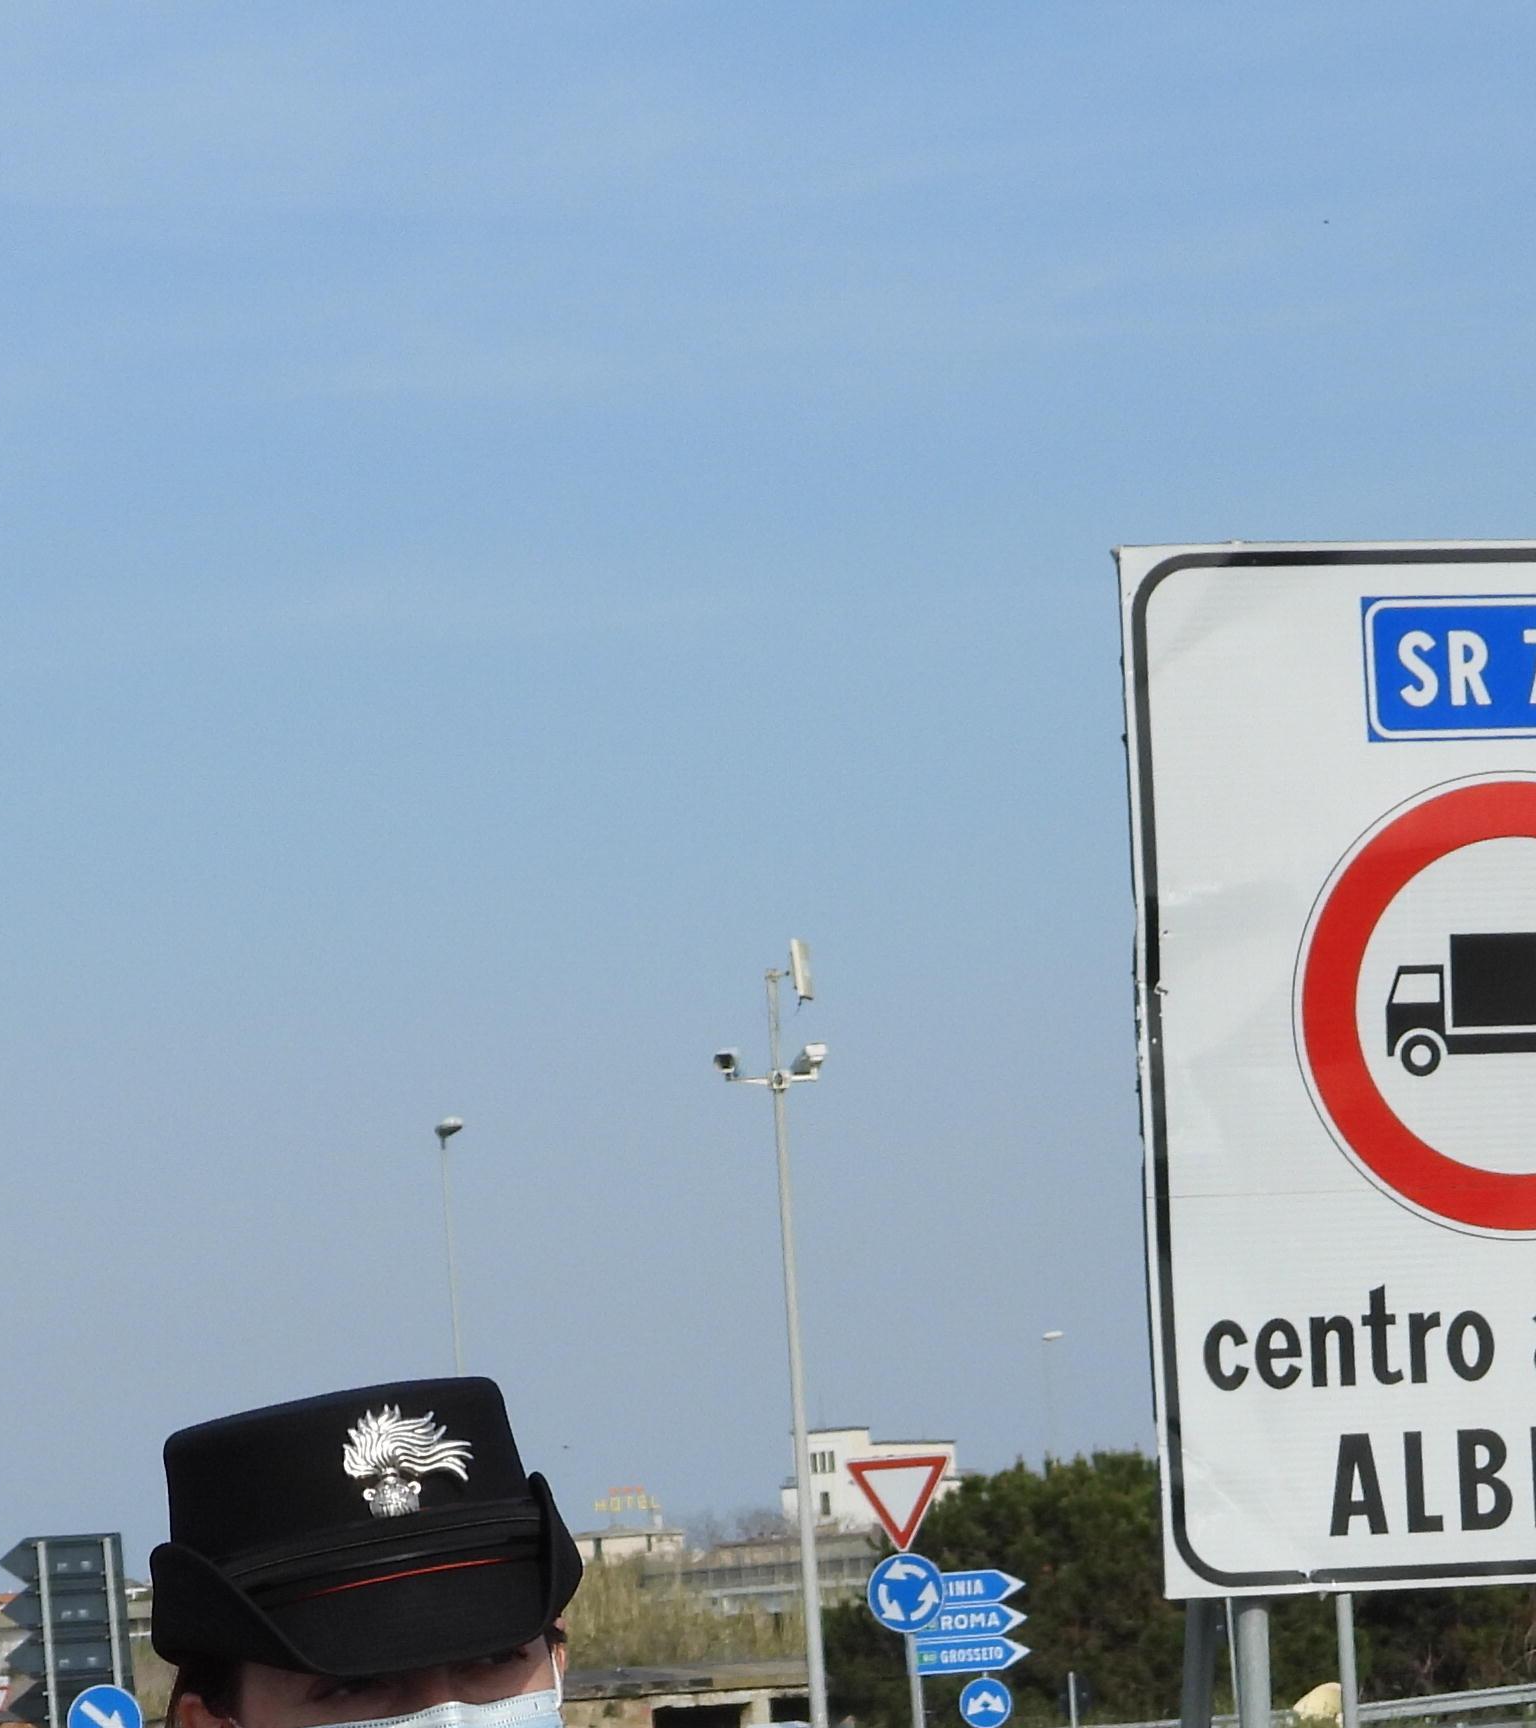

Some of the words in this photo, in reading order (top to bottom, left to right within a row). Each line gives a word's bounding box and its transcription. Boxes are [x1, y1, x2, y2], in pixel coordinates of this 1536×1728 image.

[1396, 630, 1490, 708] SR
[1202, 1283, 1495, 1391] centro
[944, 1579, 984, 1597] INIA
[940, 1612, 1000, 1630] ROMA
[940, 1647, 1003, 1664] GROSSETO
